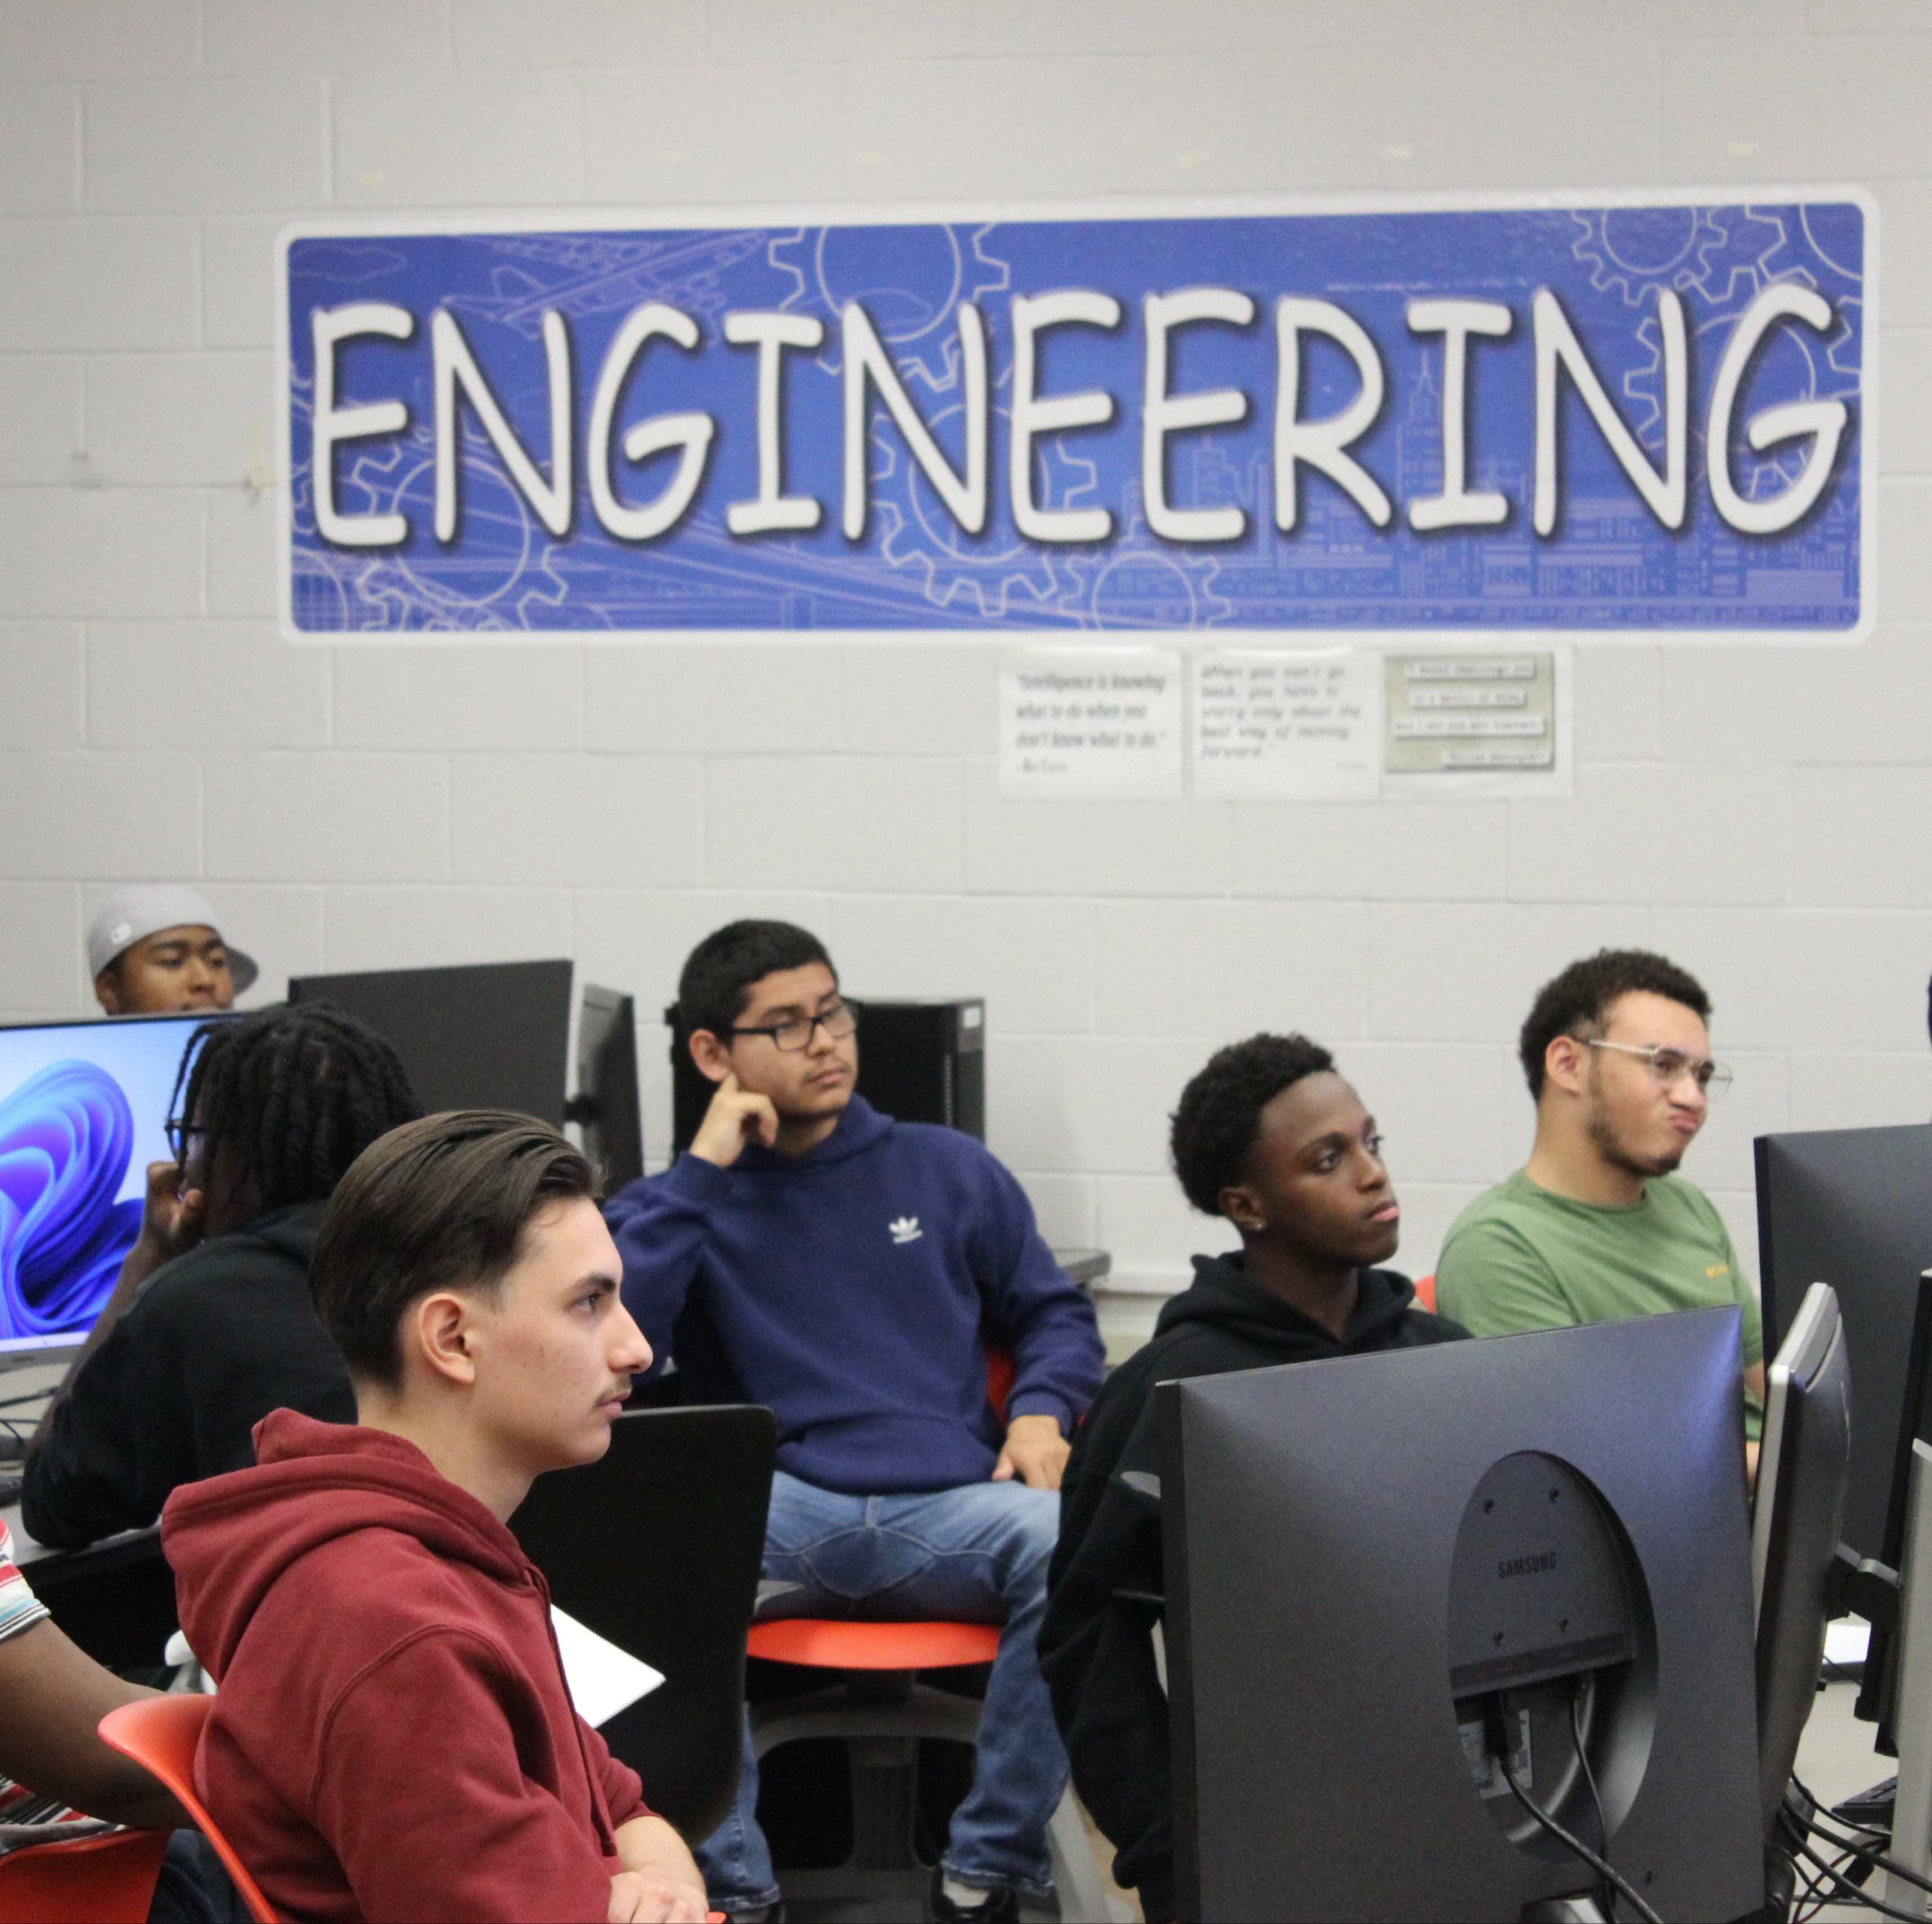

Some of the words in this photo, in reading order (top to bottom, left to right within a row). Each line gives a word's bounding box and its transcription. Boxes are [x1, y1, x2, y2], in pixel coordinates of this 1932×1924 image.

[312, 284, 1849, 544] ENGINEERING
[1098, 674, 1107, 690] is
[1111, 673, 1165, 694] knowing
[1016, 702, 1047, 719] what
[1050, 704, 1063, 719] to
[1066, 702, 1083, 719] do
[1086, 702, 1120, 719] when
[1122, 706, 1147, 722] you
[1052, 731, 1085, 748] know
[1089, 731, 1121, 748] what
[1124, 732, 1135, 748] to
[1498, 1552, 1557, 1579] SAMSUNG
